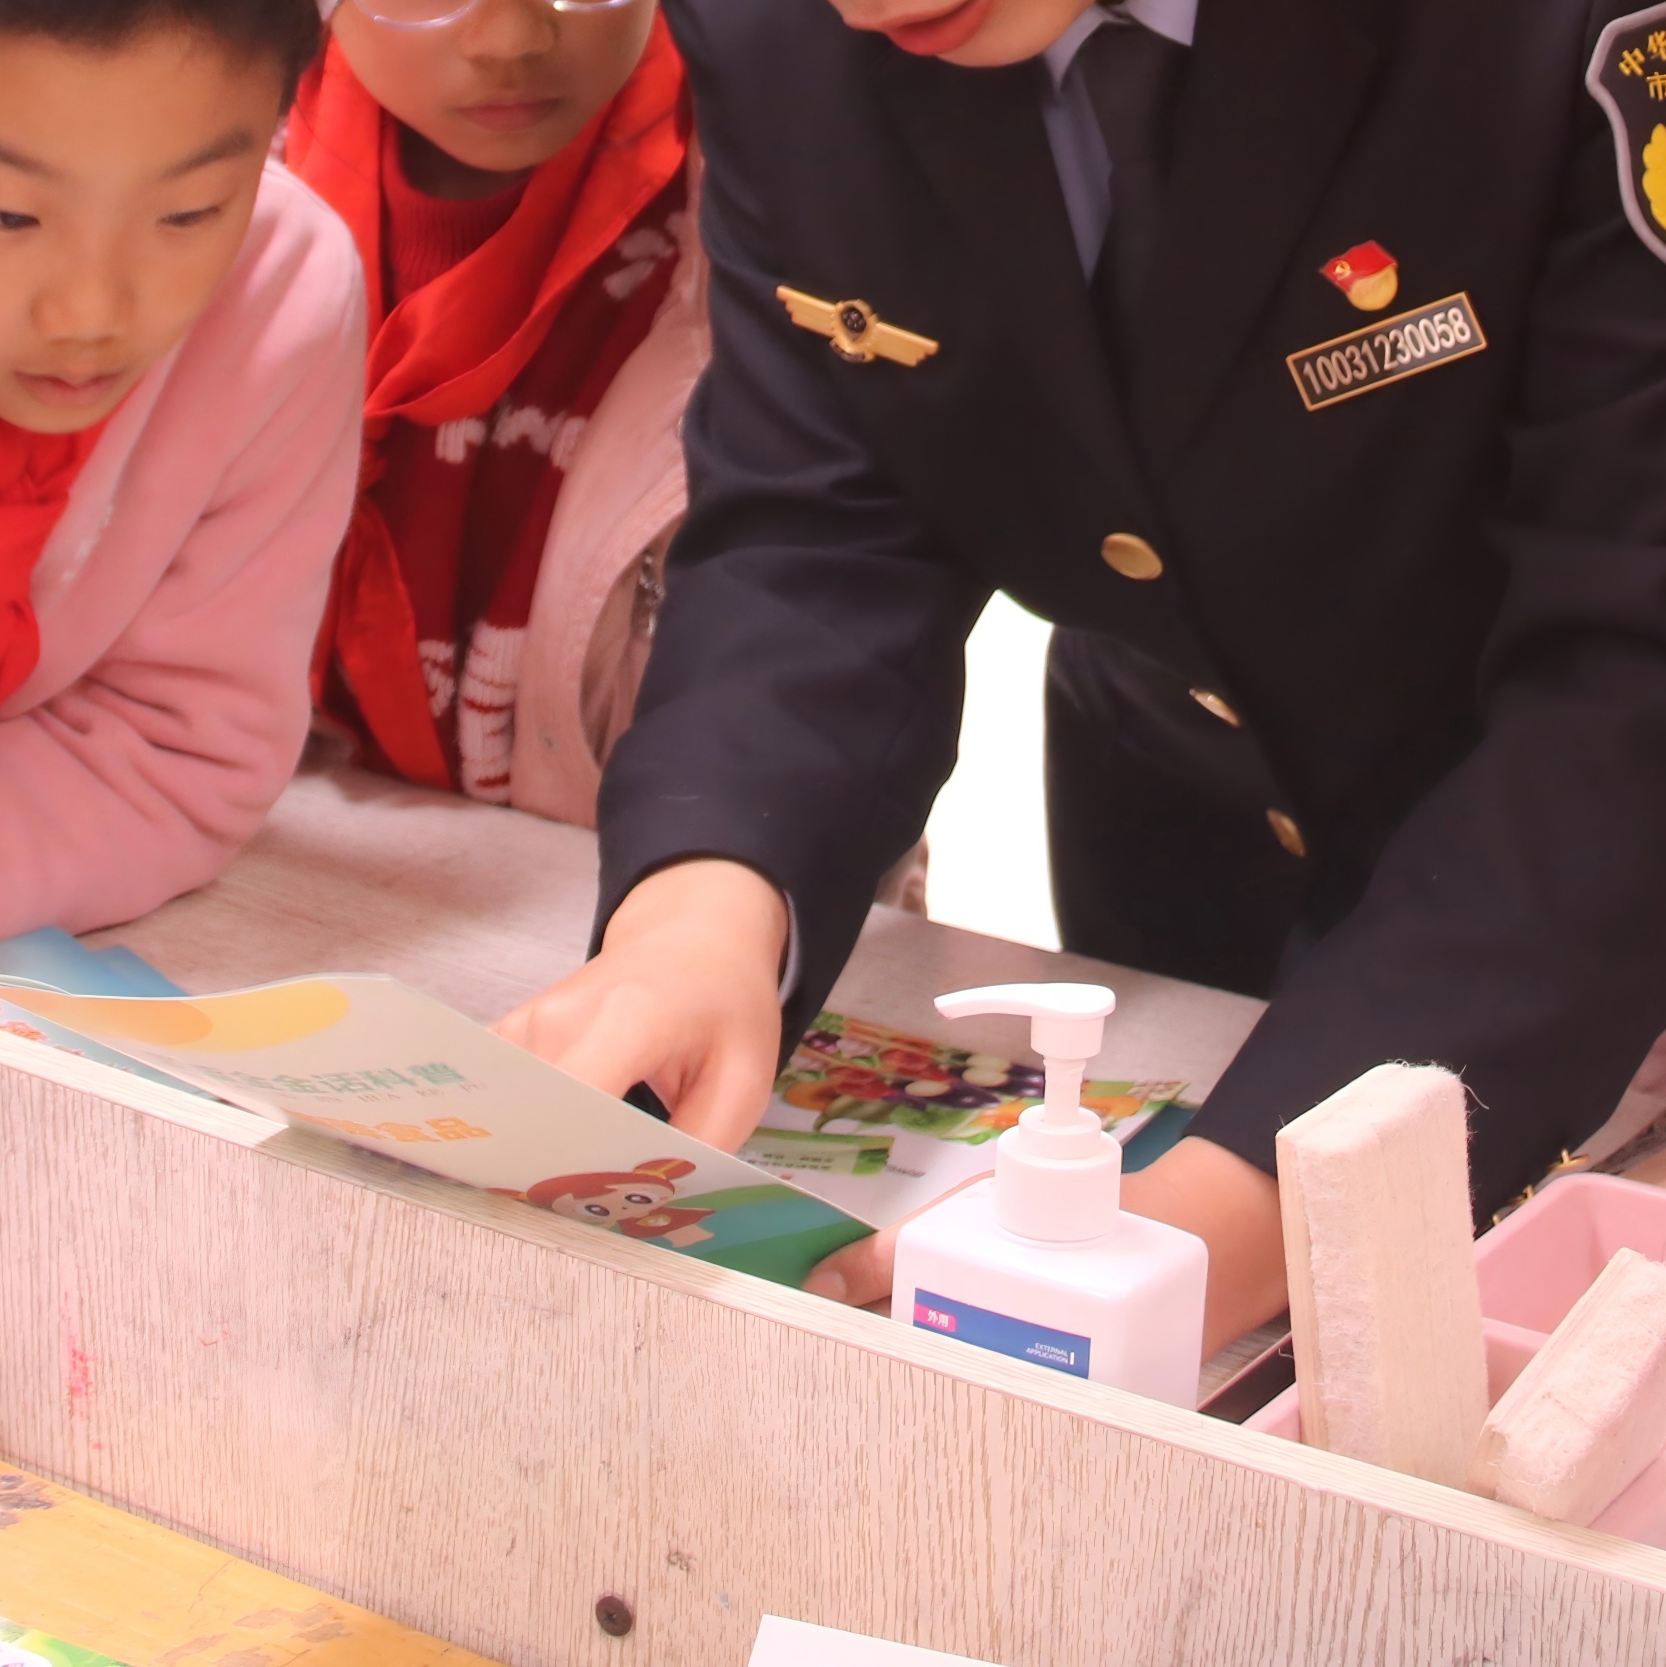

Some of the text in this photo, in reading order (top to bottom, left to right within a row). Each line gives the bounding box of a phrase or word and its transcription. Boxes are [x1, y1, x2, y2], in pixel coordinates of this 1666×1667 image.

[1303, 306, 1471, 395] 10031230058
[927, 1309, 949, 1328] 外用
[1035, 1342, 1068, 1357] EXTERNAL
